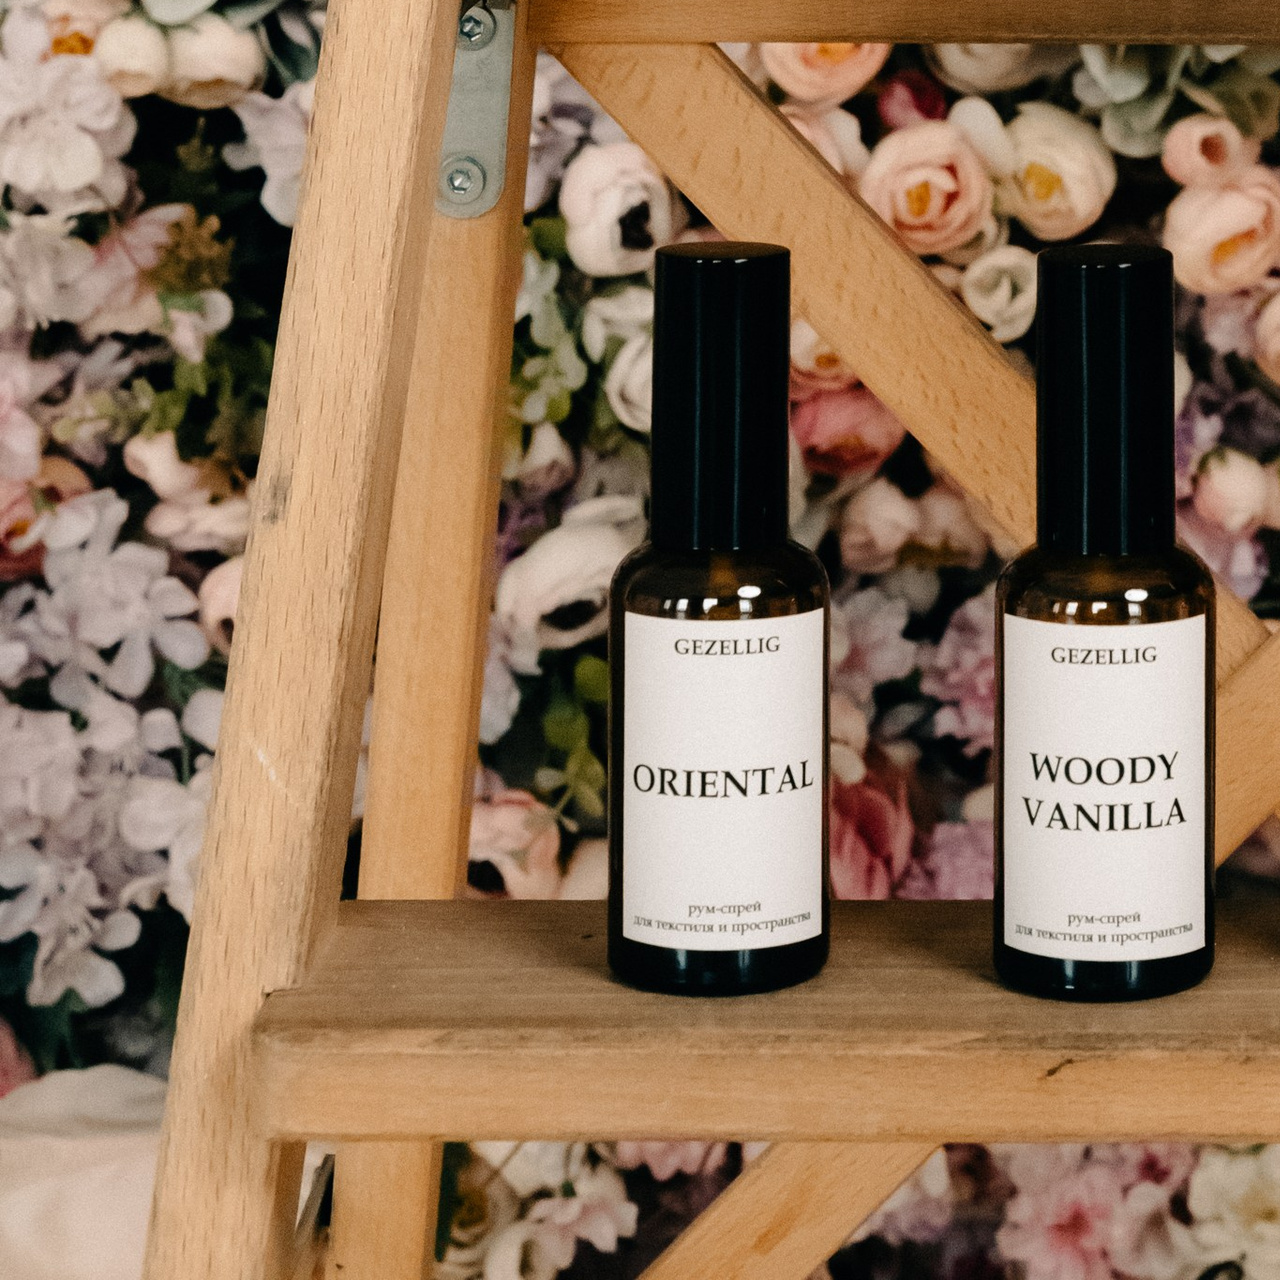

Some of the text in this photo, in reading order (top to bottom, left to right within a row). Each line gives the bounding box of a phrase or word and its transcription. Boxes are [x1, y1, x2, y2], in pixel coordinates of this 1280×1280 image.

[674, 636, 780, 656] GEZELLIG
[1050, 646, 1157, 665] GEZELLIG
[632, 759, 814, 798] ORIENTAL
[1029, 751, 1179, 786] WOODY
[1021, 796, 1187, 832] VANILLA
[688, 900, 762, 916] рум-спрей
[1068, 911, 1141, 927] рум-спрей
[633, 911, 811, 935] для текстиля и пространства
[1015, 921, 1193, 946] для текстиля и пространства
